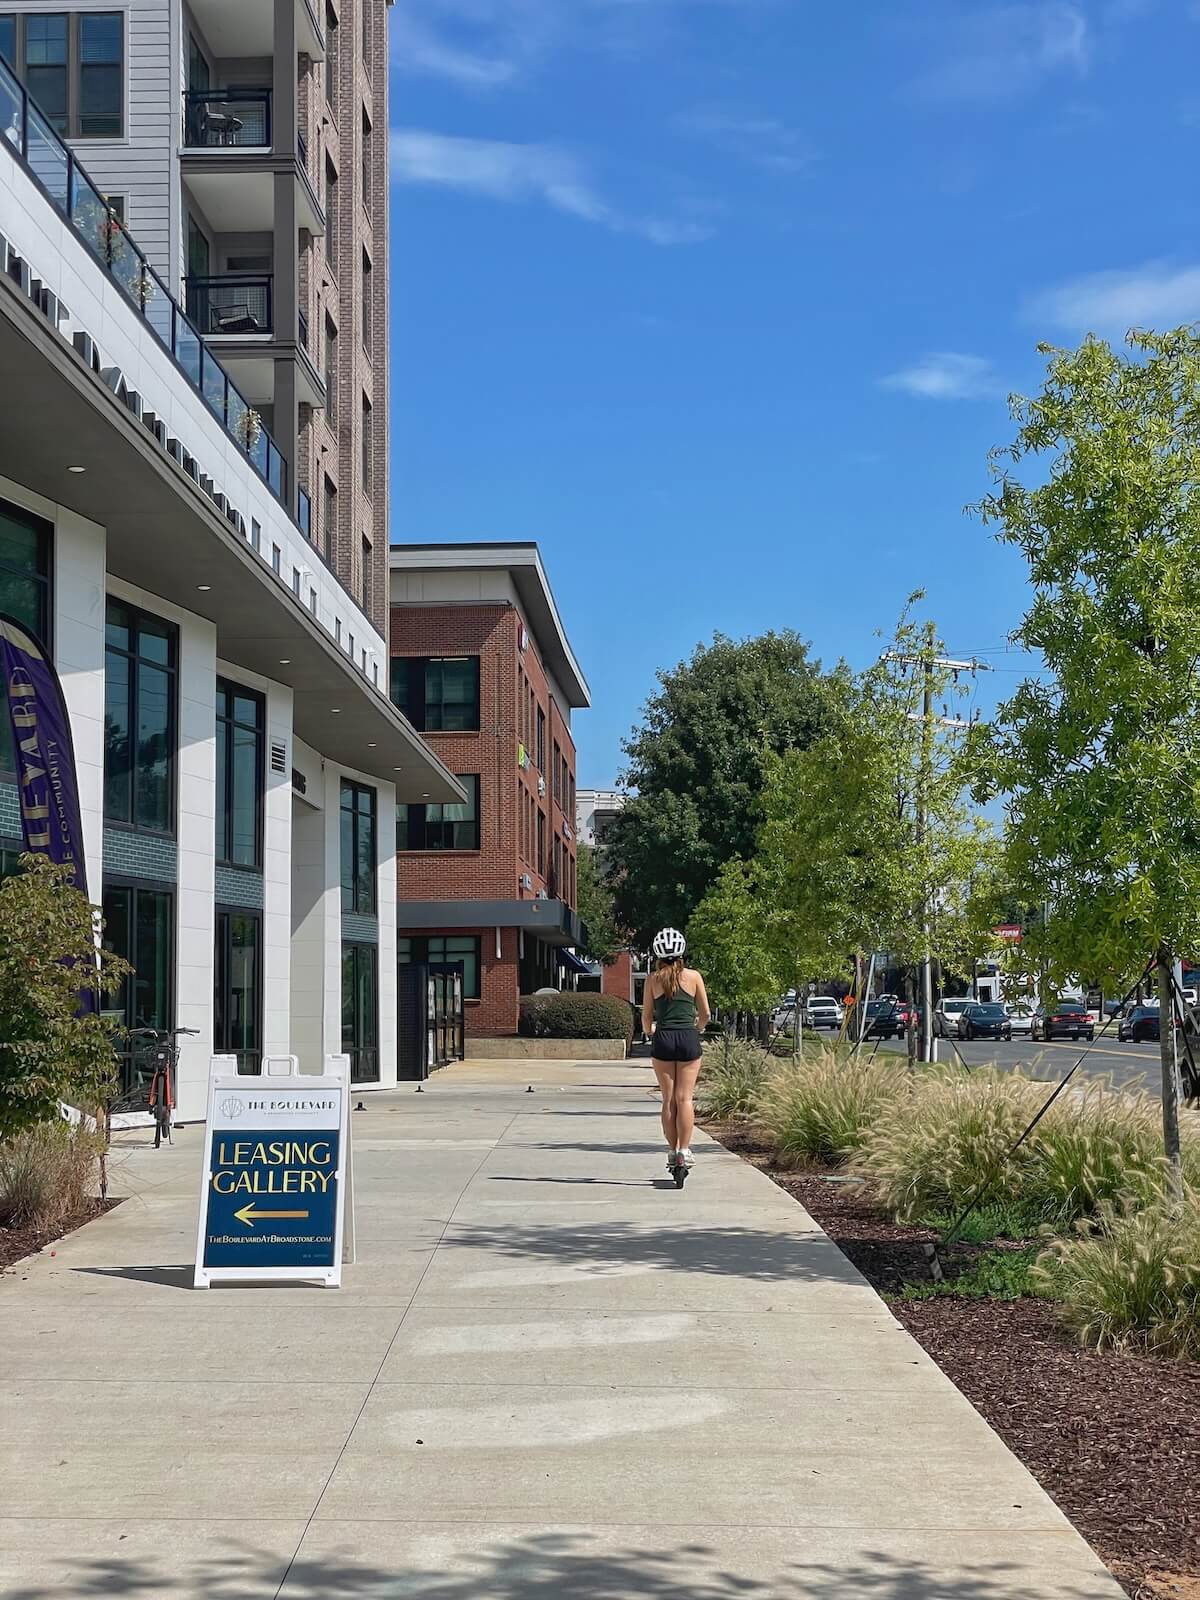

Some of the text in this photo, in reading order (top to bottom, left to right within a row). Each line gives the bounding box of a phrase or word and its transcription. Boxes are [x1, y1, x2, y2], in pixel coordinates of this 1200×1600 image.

[47, 739, 71, 843] COMMUNITY
[248, 1101, 336, 1109] THE BOULEVARD
[219, 1142, 331, 1165] LEASING
[212, 1170, 335, 1194] GALLERY
